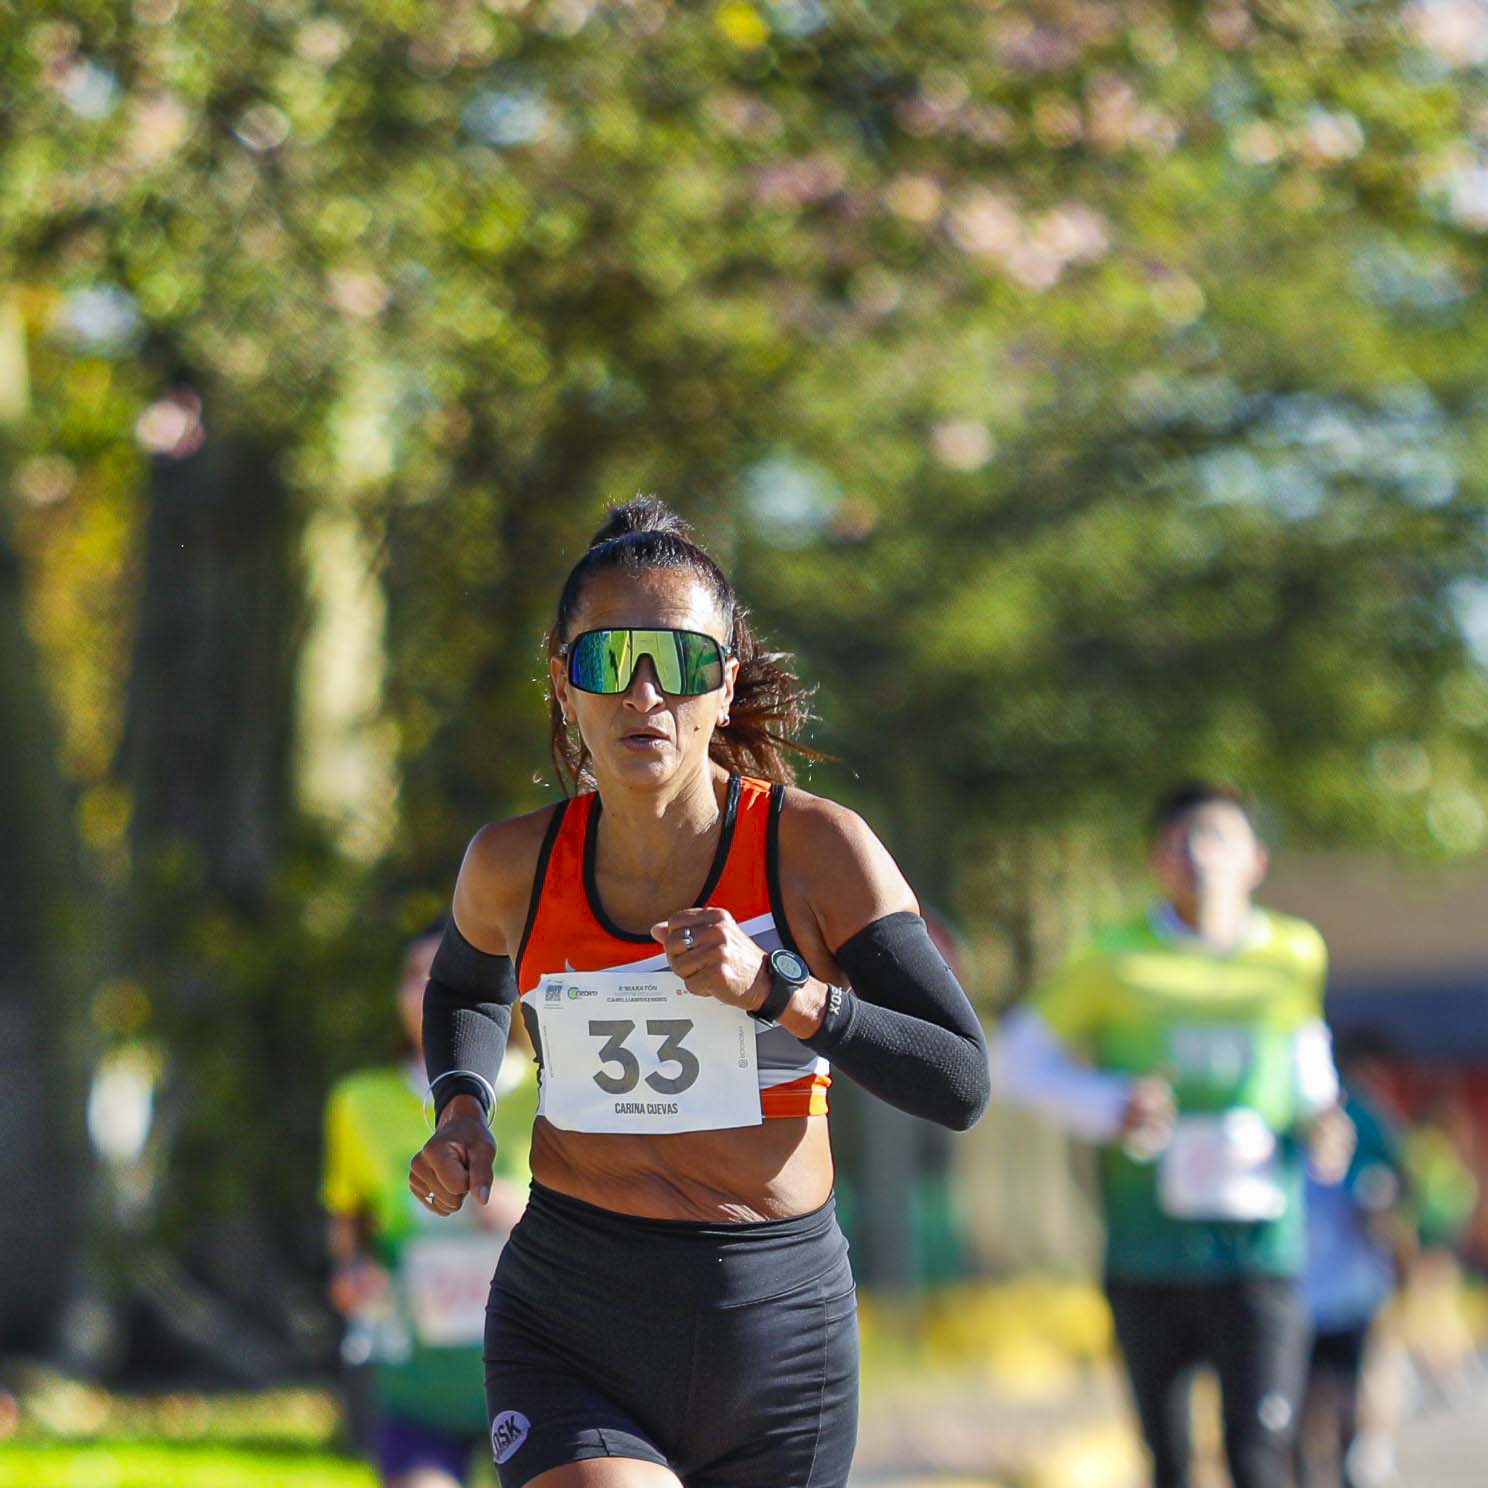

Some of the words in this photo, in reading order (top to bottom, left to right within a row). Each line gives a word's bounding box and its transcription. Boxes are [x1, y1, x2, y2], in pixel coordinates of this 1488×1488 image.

[588, 1019, 700, 1095] 33
[614, 1102, 645, 1115] CARINA
[646, 1102, 679, 1116] CUEVAS
